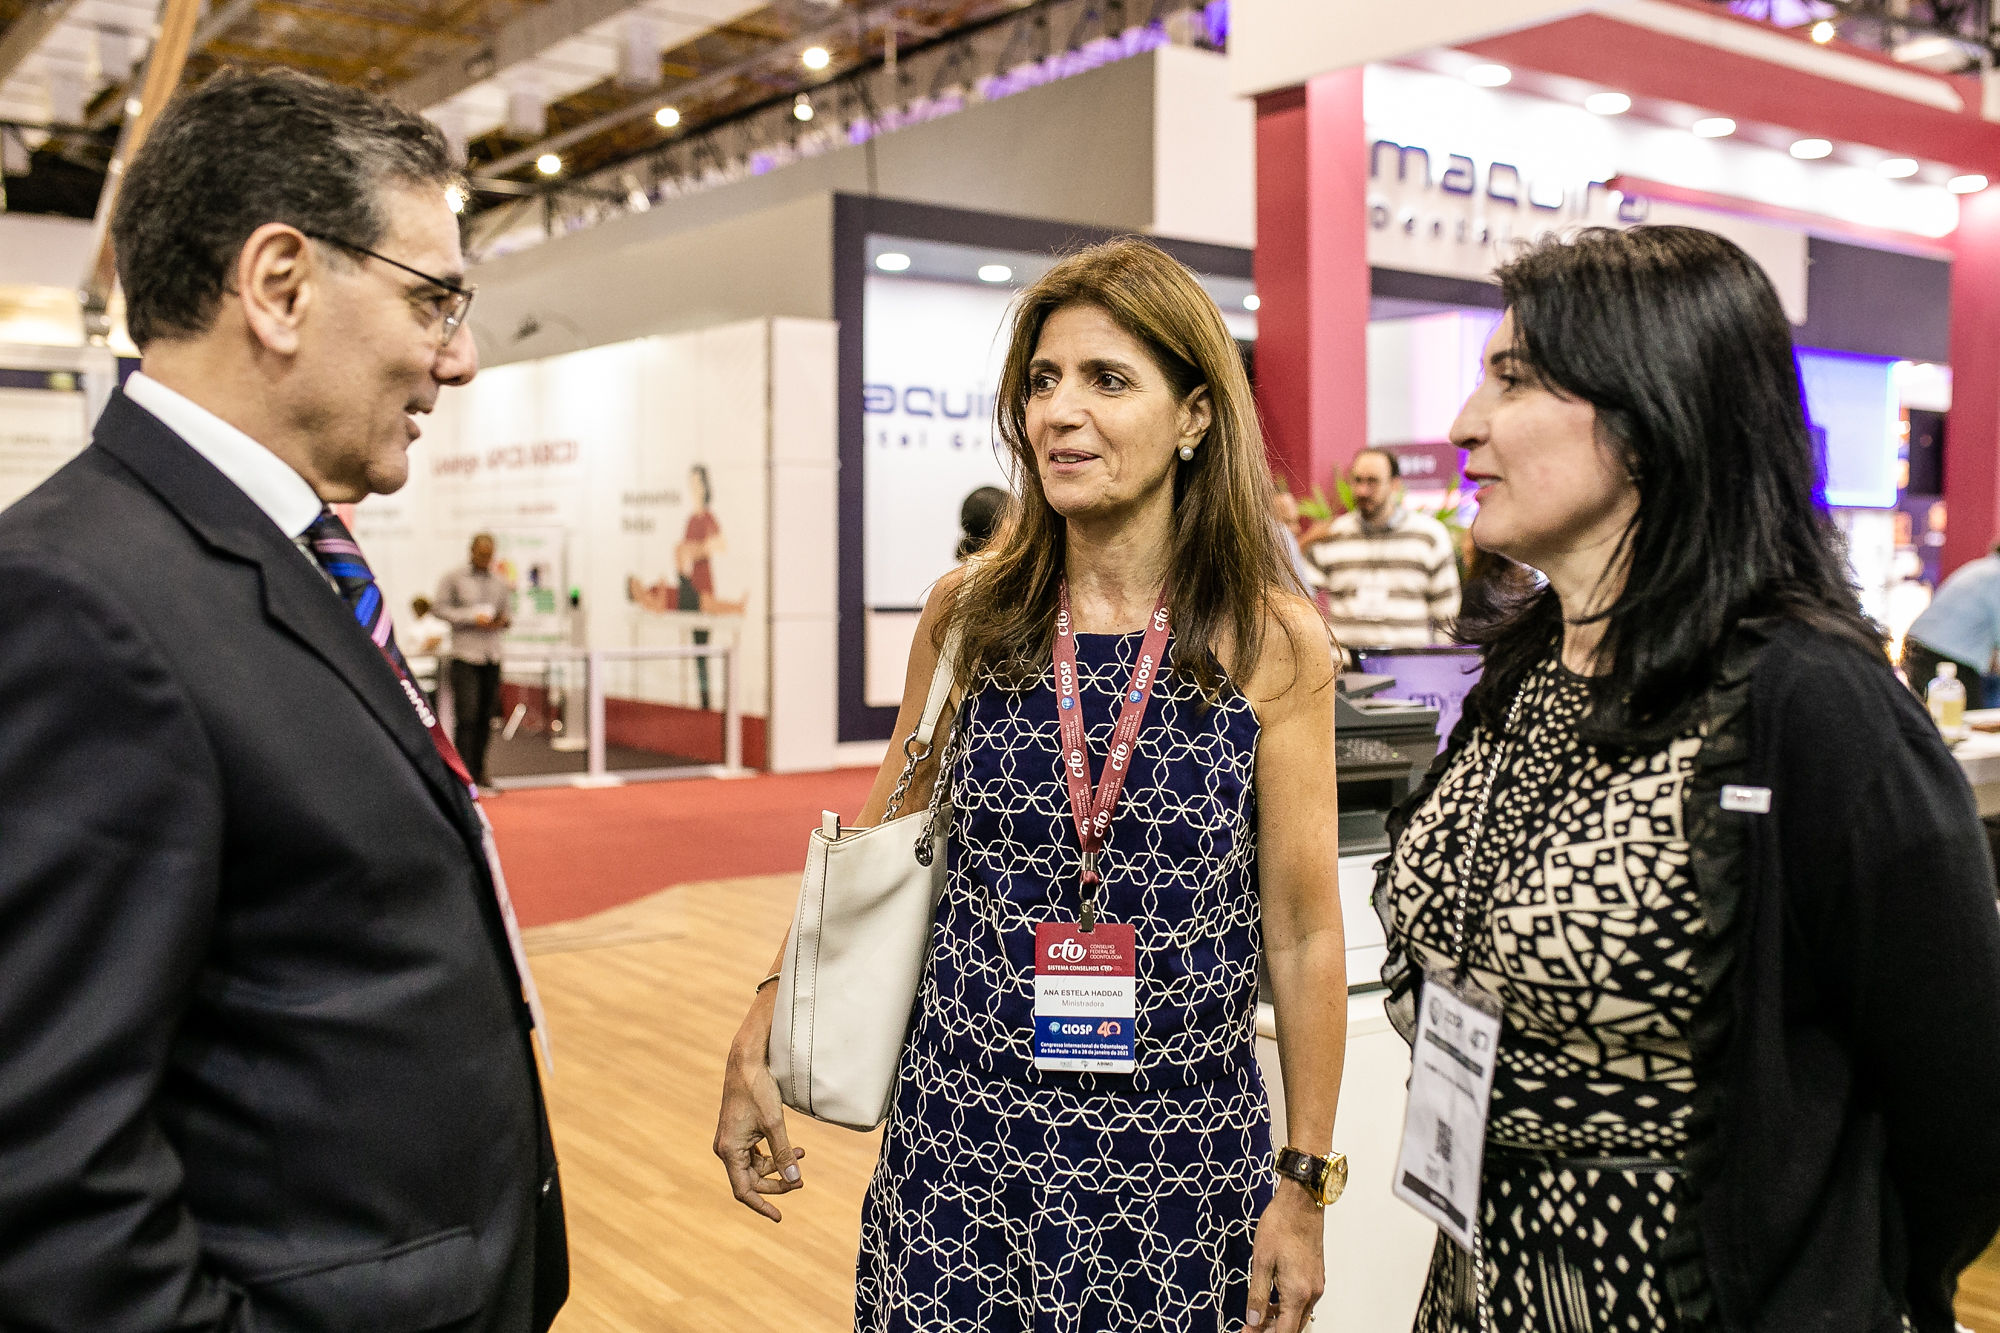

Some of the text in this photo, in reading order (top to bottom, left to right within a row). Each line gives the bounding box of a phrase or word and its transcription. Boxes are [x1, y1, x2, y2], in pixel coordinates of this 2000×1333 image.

[1060, 661, 1073, 695] CIOSP
[1135, 655, 1153, 689] CIOSP
[1067, 749, 1085, 778] cfo
[1111, 742, 1130, 771] cfo
[1093, 809, 1111, 838] cfo
[1047, 938, 1087, 963] cfo
[1061, 1000, 1105, 1008] Ministradora
[1062, 1021, 1122, 1038] CIOSP 40
[1040, 1041, 1064, 1049] Congresso
